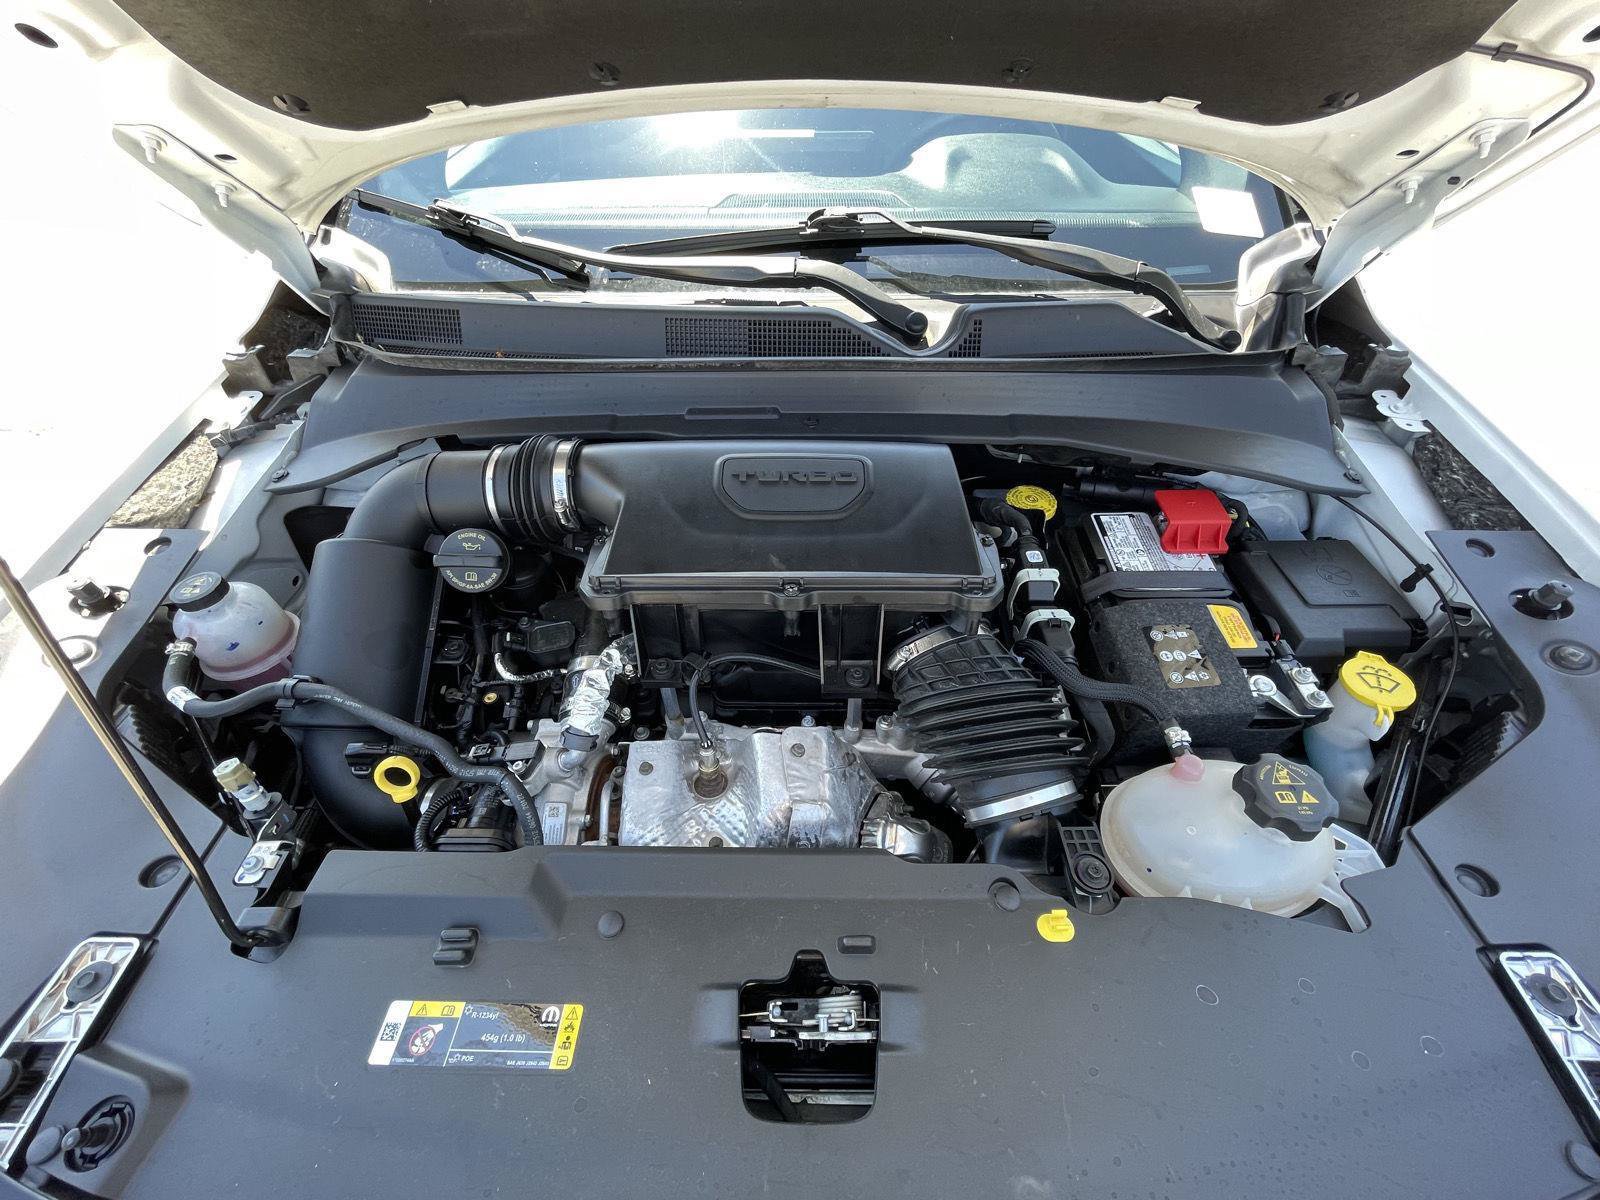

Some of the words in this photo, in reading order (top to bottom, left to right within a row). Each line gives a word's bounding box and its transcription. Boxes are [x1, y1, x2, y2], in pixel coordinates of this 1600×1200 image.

[731, 469, 859, 485] TURBO
[457, 532, 477, 540] ENGINE
[477, 533, 487, 542] OIL
[471, 1011, 500, 1021] R-1234yf
[480, 1032, 499, 1044] 454g
[499, 1032, 514, 1044] (1.0
[515, 1032, 526, 1044] lb)
